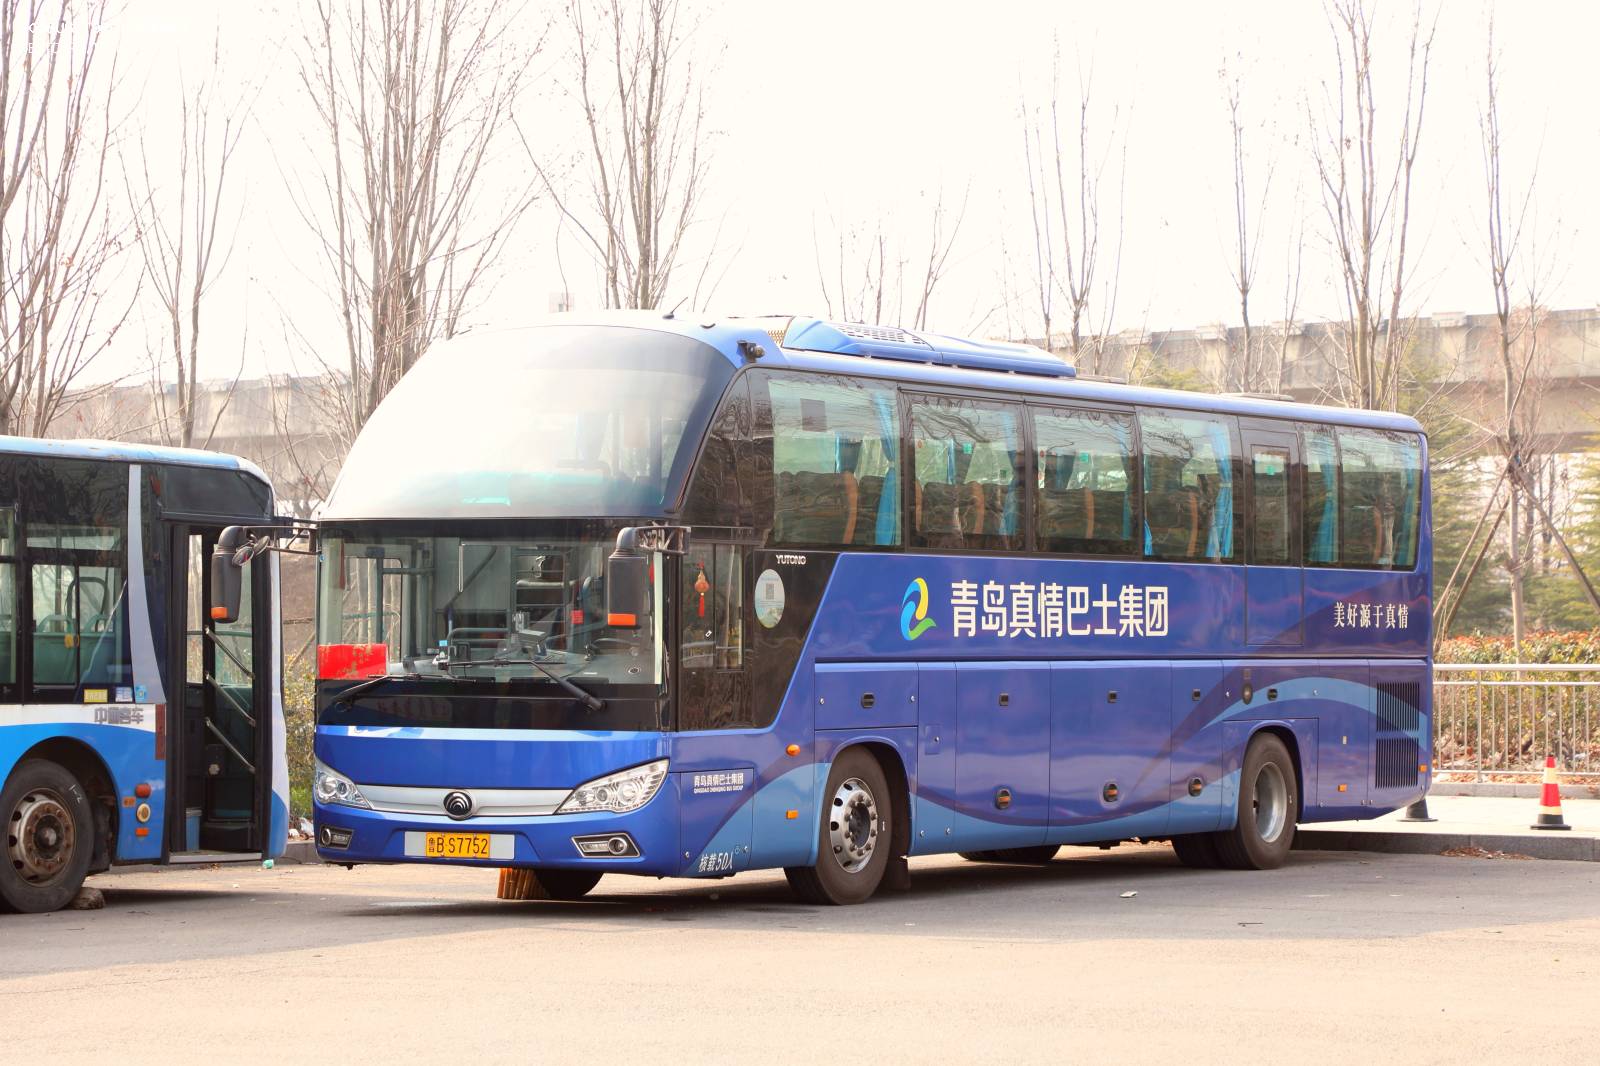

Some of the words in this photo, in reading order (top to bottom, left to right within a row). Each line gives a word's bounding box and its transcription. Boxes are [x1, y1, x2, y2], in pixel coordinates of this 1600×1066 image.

[776, 554, 807, 565] YUTONG
[950, 579, 1169, 638] 青岛真情巴士集团
[1333, 601, 1409, 629] 美好源于真情
[698, 851, 733, 872] 核载50人
